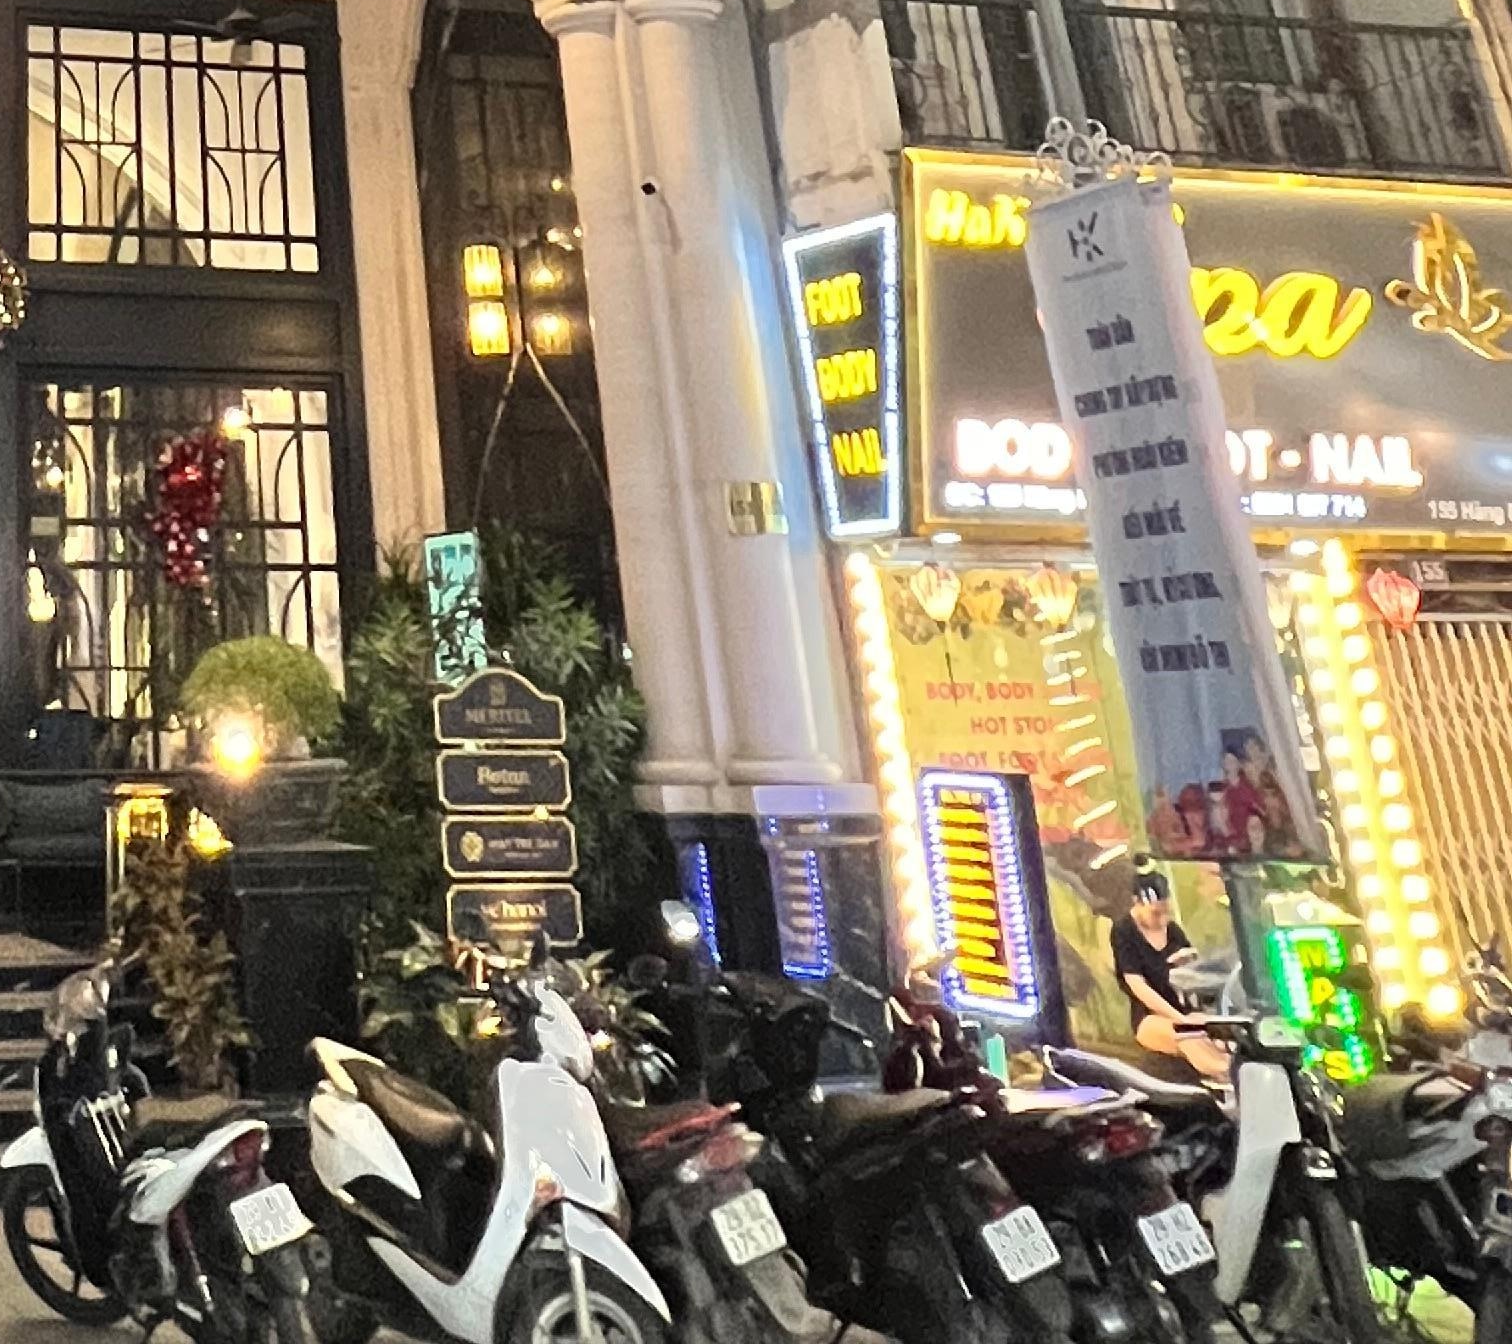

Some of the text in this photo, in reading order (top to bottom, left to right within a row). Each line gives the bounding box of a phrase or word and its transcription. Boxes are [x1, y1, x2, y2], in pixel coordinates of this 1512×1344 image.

[804, 272, 863, 326] FOOT
[816, 348, 877, 401] BODY
[832, 428, 888, 476] NAIL
[955, 418, 1073, 479] BOD
[1308, 431, 1425, 489] NAIL
